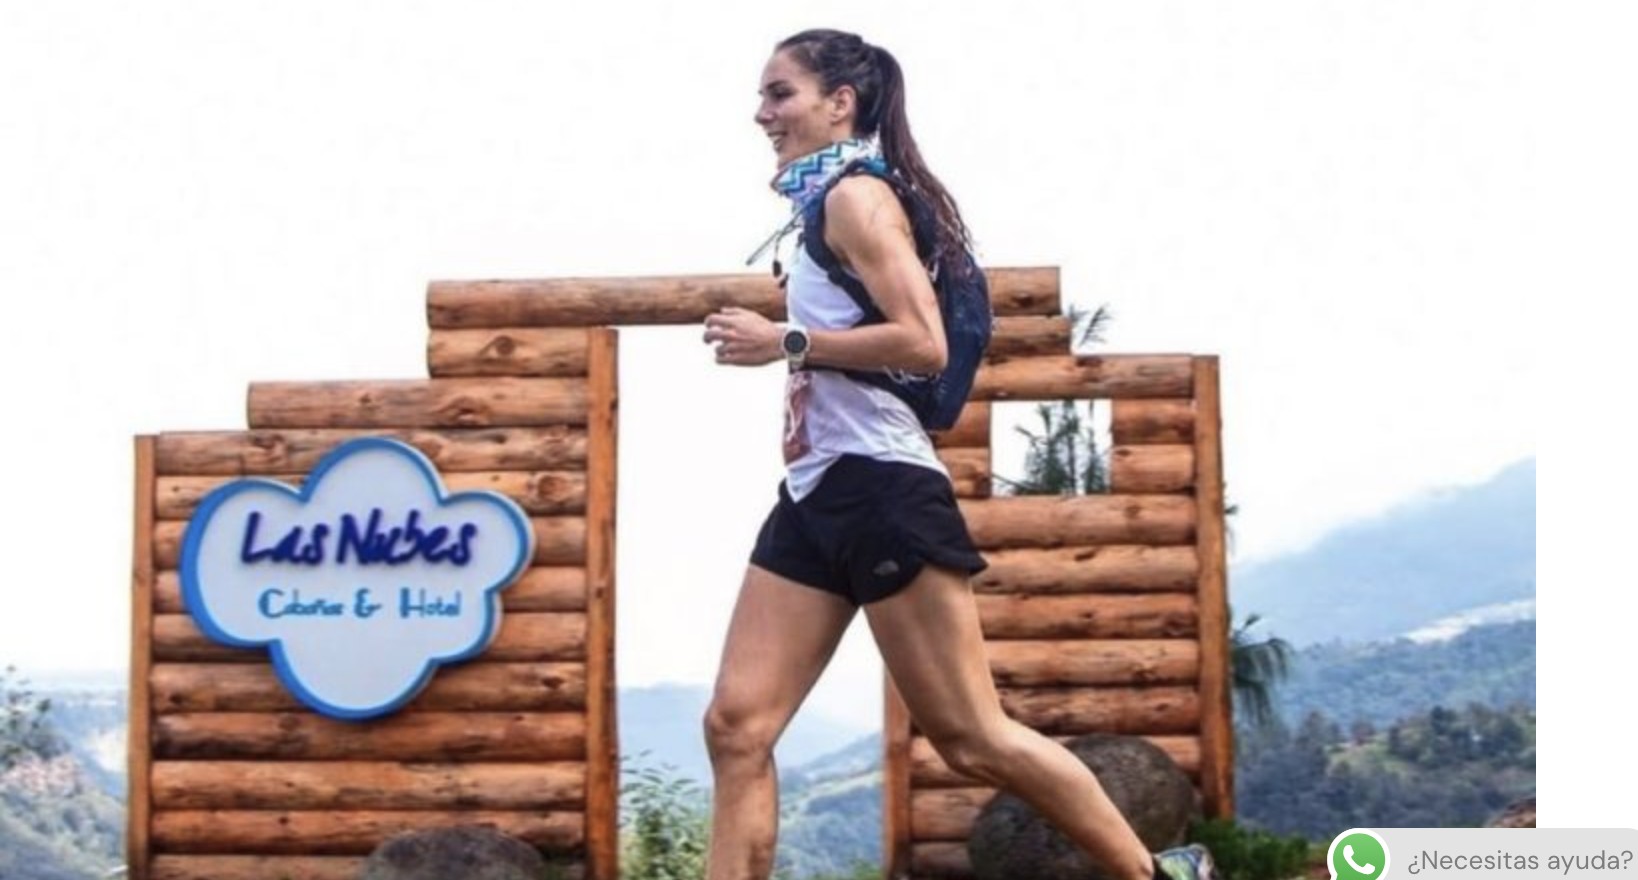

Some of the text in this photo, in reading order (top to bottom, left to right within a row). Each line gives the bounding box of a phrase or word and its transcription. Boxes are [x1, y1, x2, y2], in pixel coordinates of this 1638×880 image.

[240, 508, 477, 566] Las Nubes
[353, 588, 382, 618] &
[400, 587, 462, 618] Hotel
